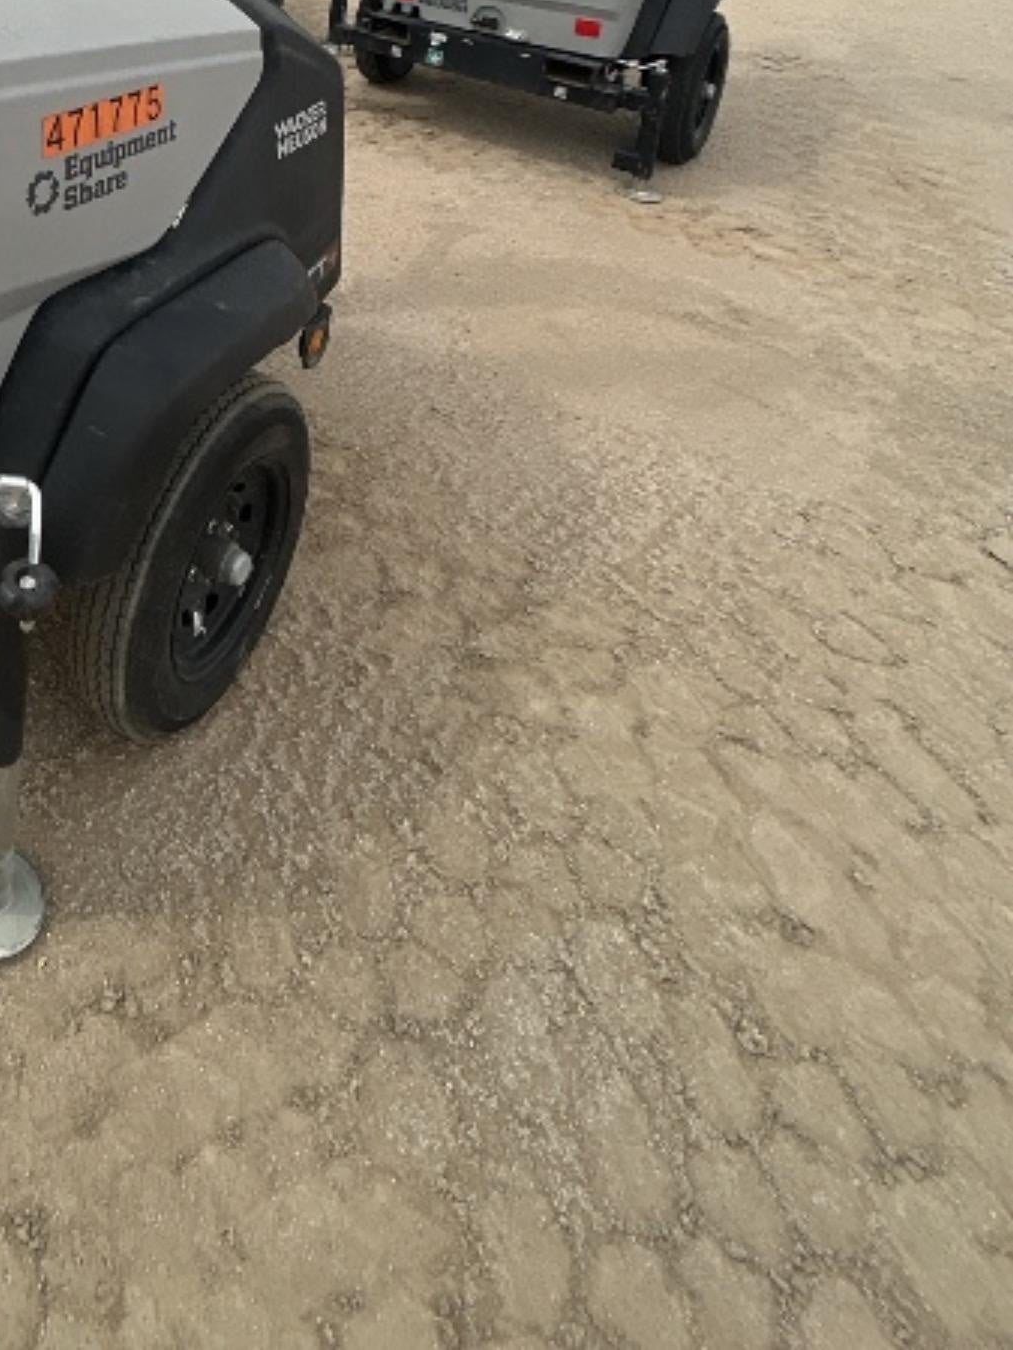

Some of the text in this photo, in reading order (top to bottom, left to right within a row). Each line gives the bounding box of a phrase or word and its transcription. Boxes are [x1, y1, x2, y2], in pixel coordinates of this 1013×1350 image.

[46, 83, 163, 151] 471775
[64, 119, 178, 181] Equipment
[63, 170, 128, 211] Share
